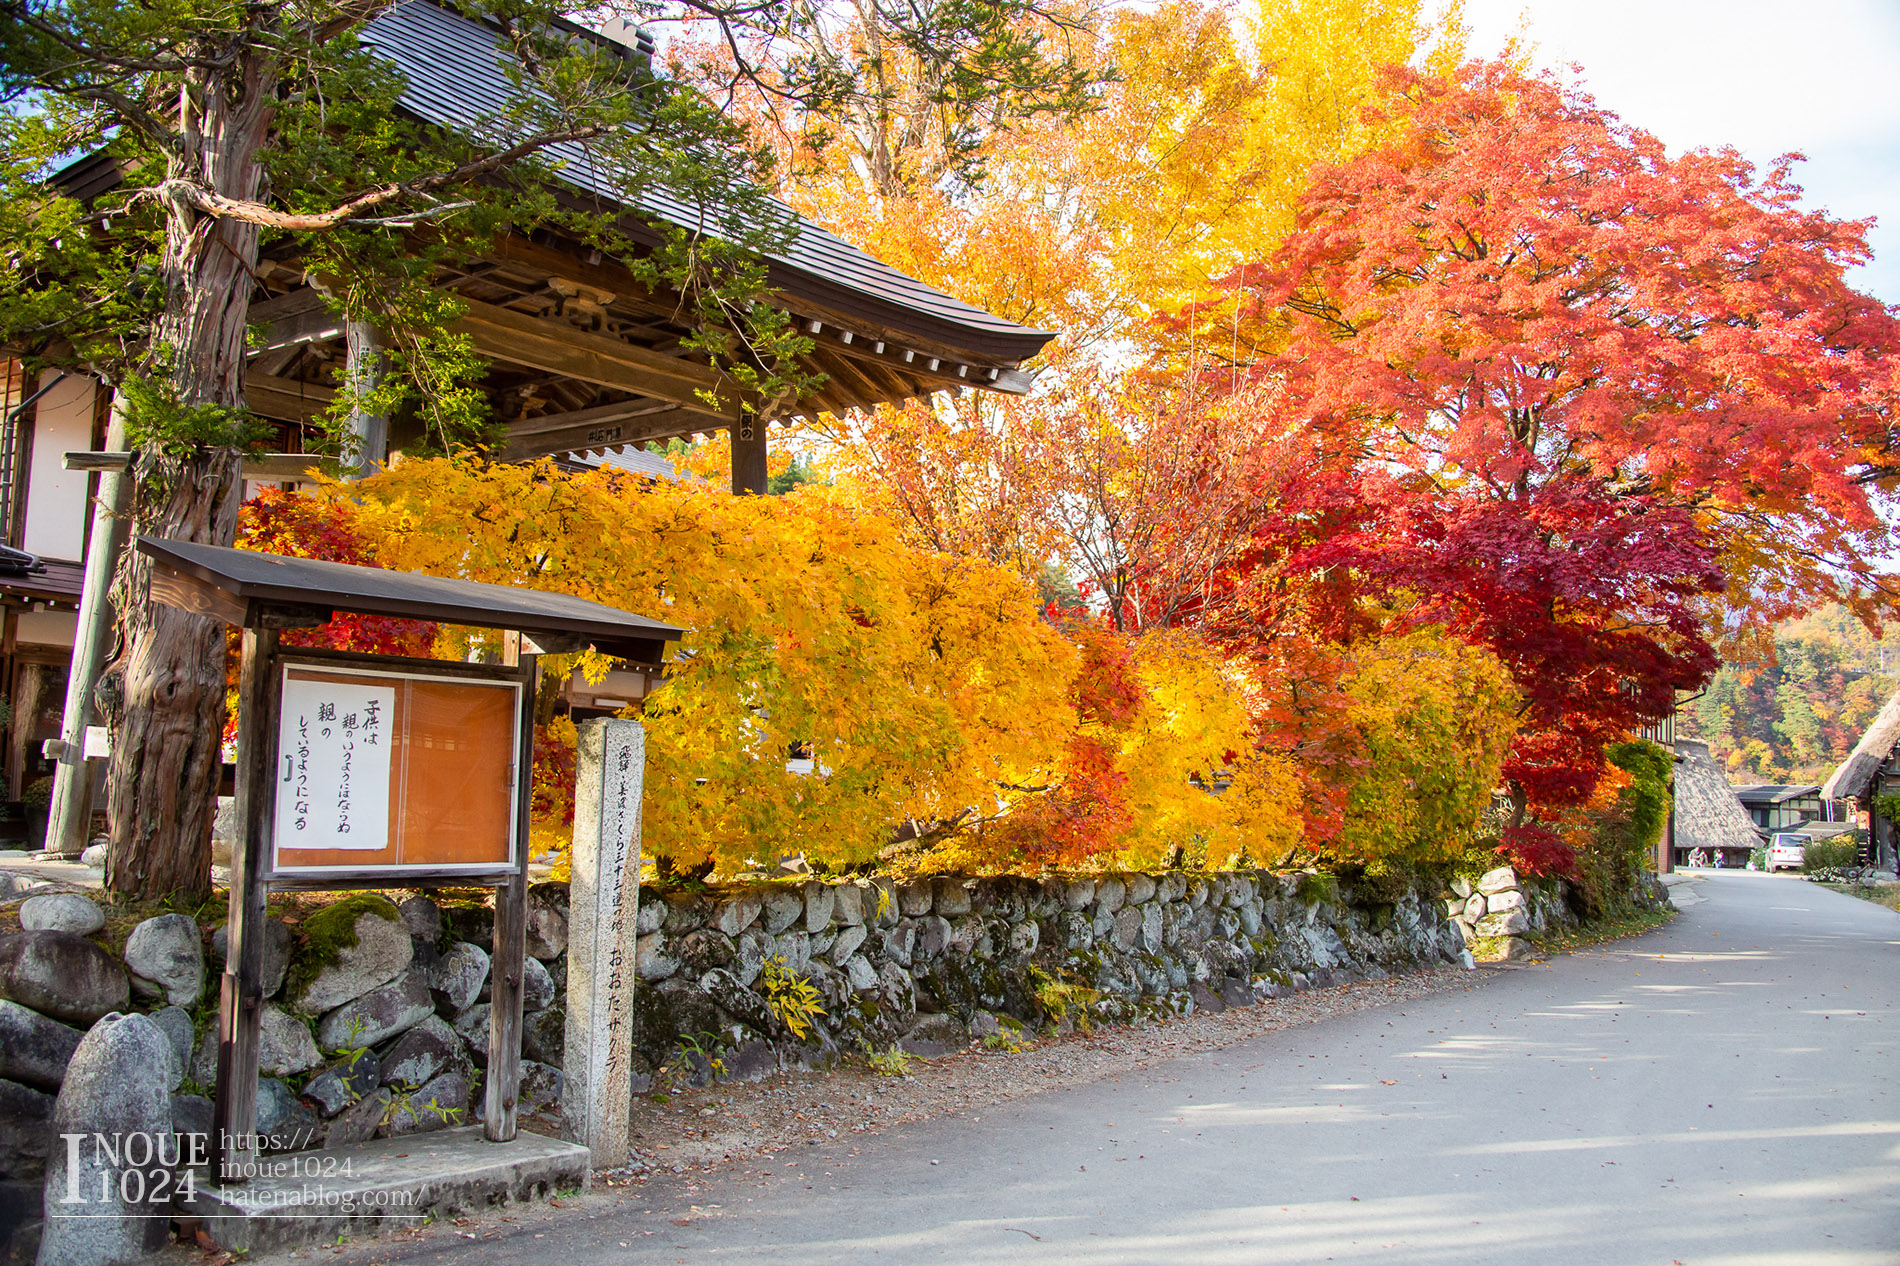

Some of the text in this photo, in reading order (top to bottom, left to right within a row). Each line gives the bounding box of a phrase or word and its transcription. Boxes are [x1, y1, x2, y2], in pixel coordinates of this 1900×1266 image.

[294, 714, 310, 831] しているようになる
[318, 702, 337, 739] 親の
[337, 713, 360, 834] 親のいうようにはならぬ
[362, 699, 381, 746] 子供は
[605, 949, 623, 1073] おおたザクラ
